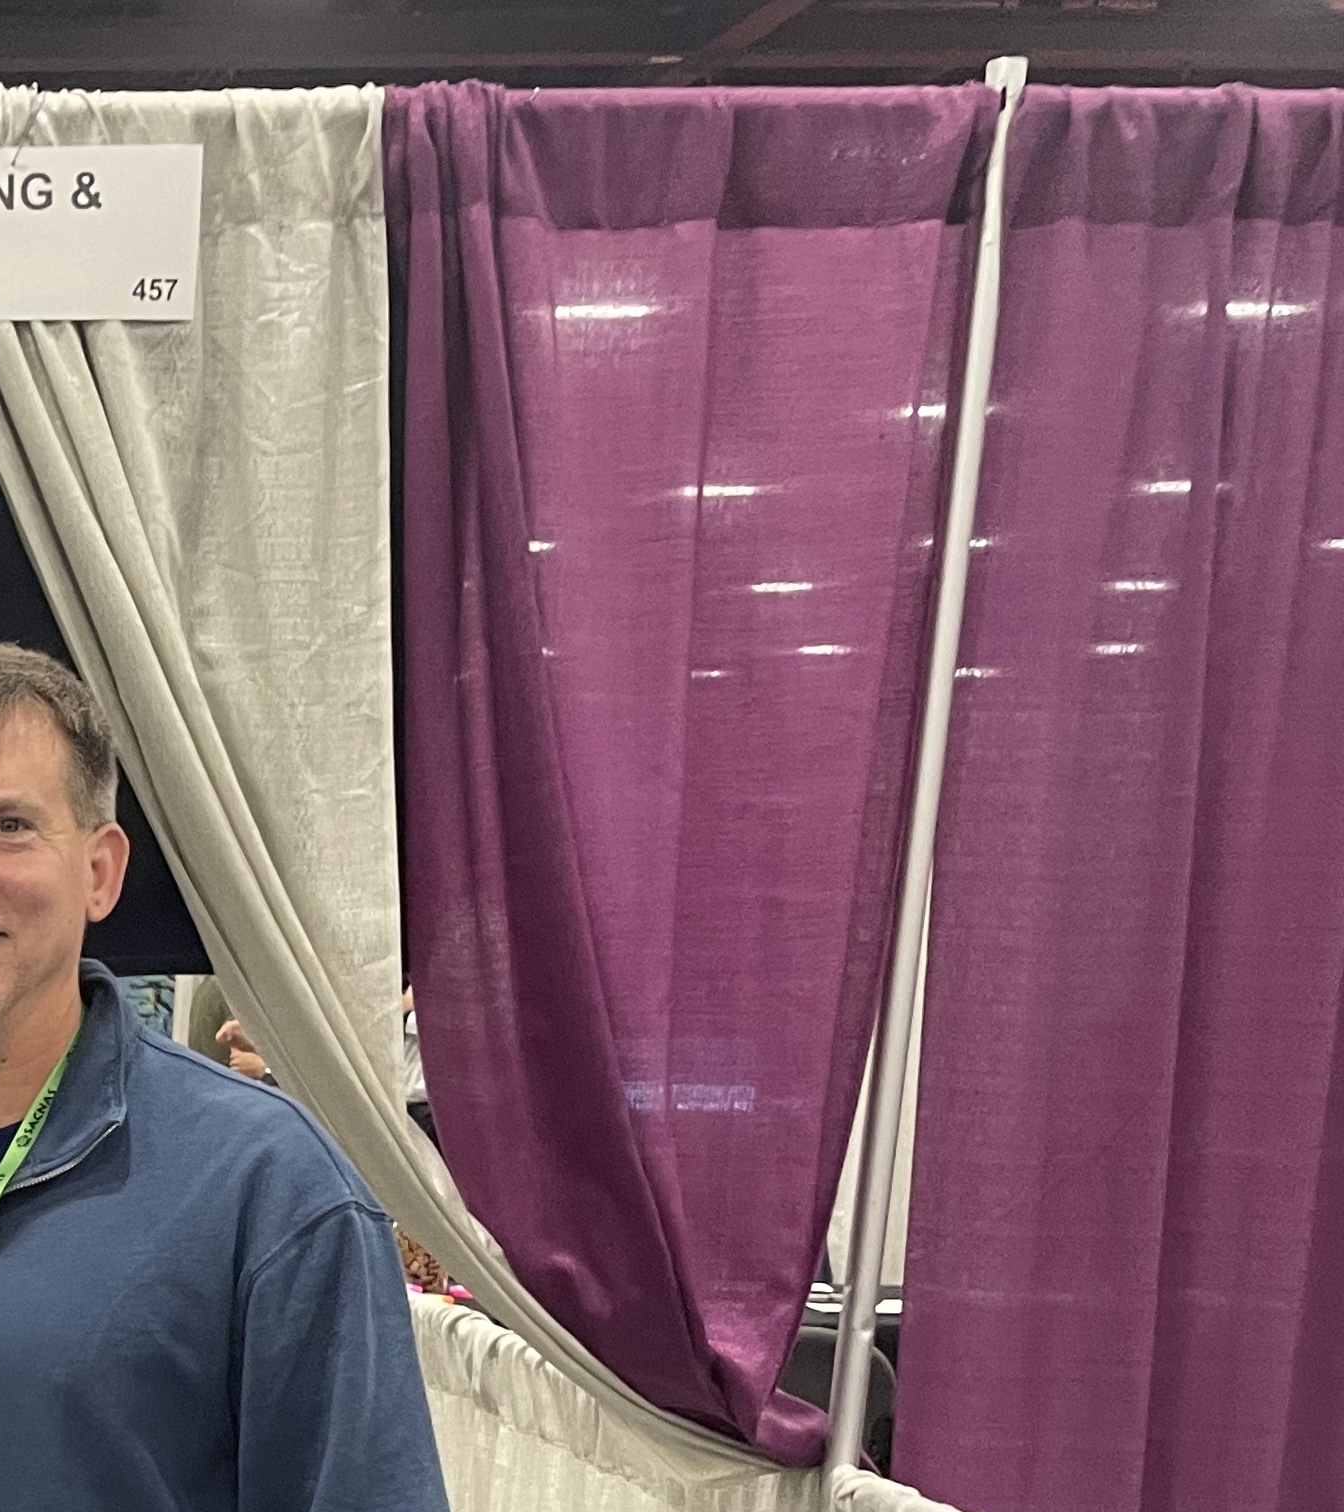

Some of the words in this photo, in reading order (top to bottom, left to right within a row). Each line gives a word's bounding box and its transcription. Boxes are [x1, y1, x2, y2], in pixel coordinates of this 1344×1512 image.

[71, 170, 103, 211] &
[132, 279, 179, 303] 457
[26, 1087, 57, 1137] SACNAS
